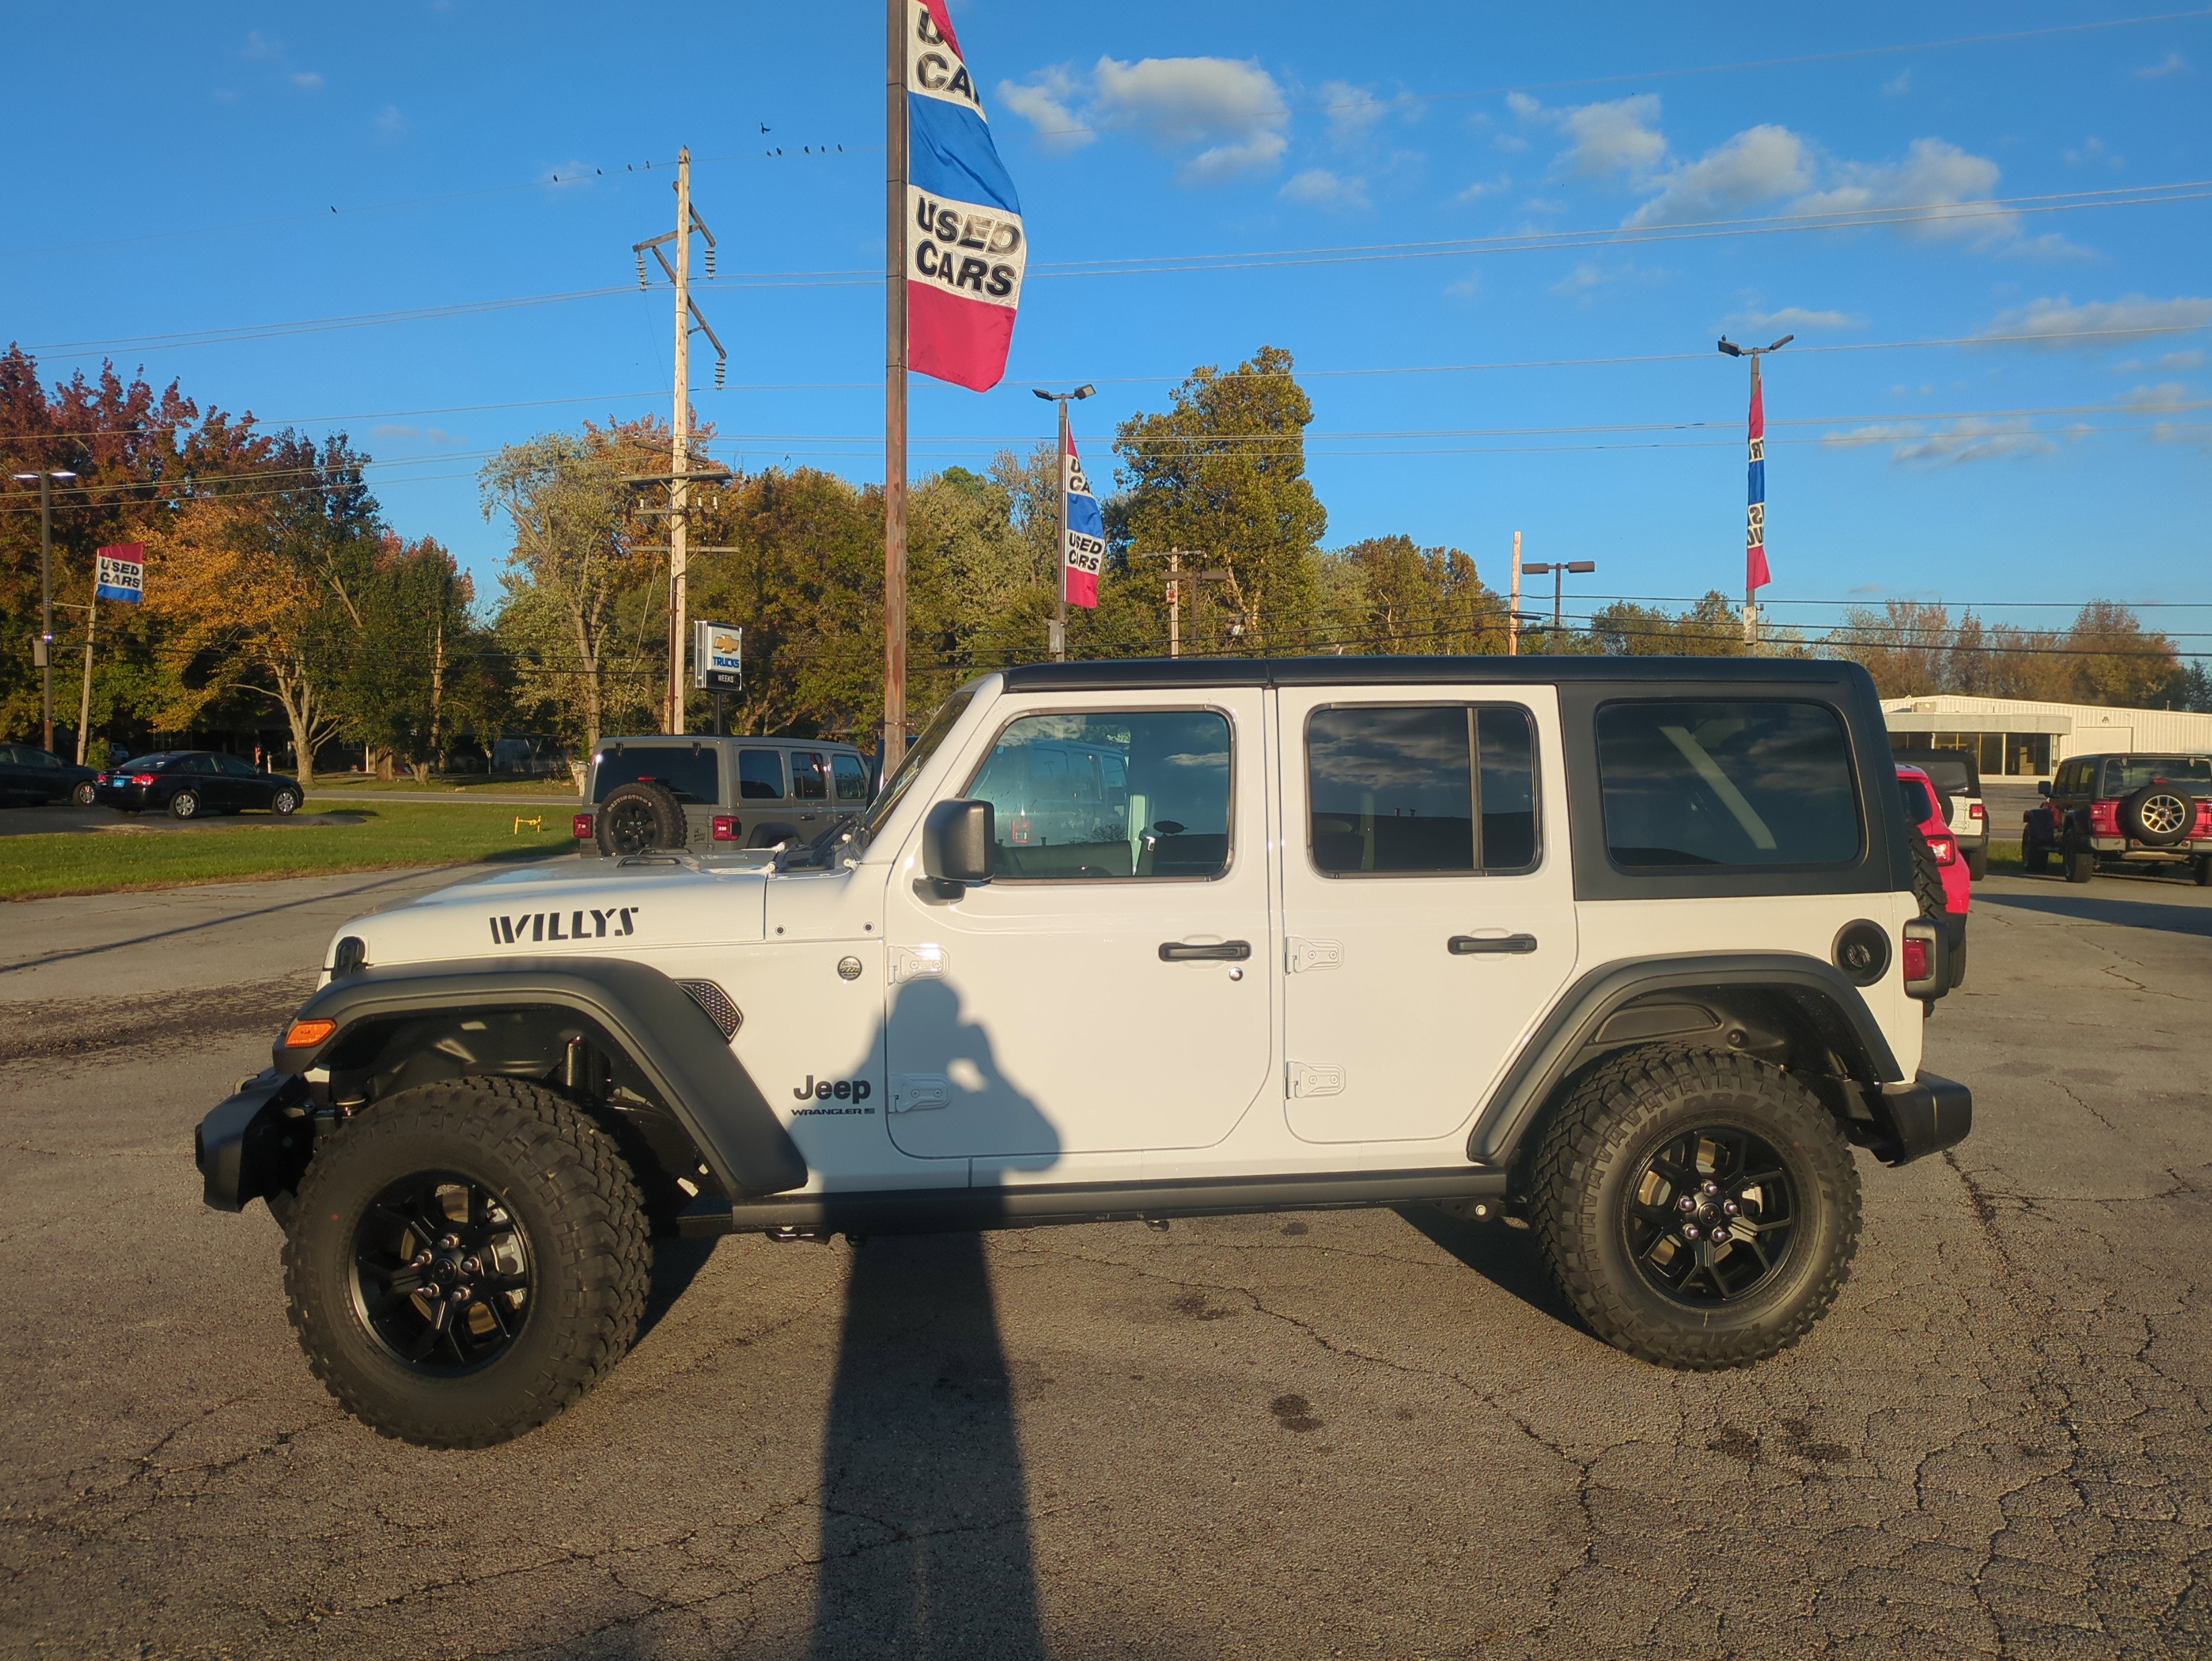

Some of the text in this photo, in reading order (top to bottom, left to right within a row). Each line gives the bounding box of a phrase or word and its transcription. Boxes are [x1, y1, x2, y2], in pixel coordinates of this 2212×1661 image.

[916, 51, 980, 107] CA
[916, 195, 1021, 255] USED
[915, 239, 1016, 297] CARS
[1070, 476, 1093, 496] CA
[1069, 532, 1102, 554] USED
[101, 558, 140, 576] USED
[100, 572, 141, 588] CARS
[712, 656, 740, 668] TRUCKS
[718, 674, 734, 683] WEEKS
[489, 907, 639, 944] WILLYS
[793, 1075, 871, 1104] Jeep
